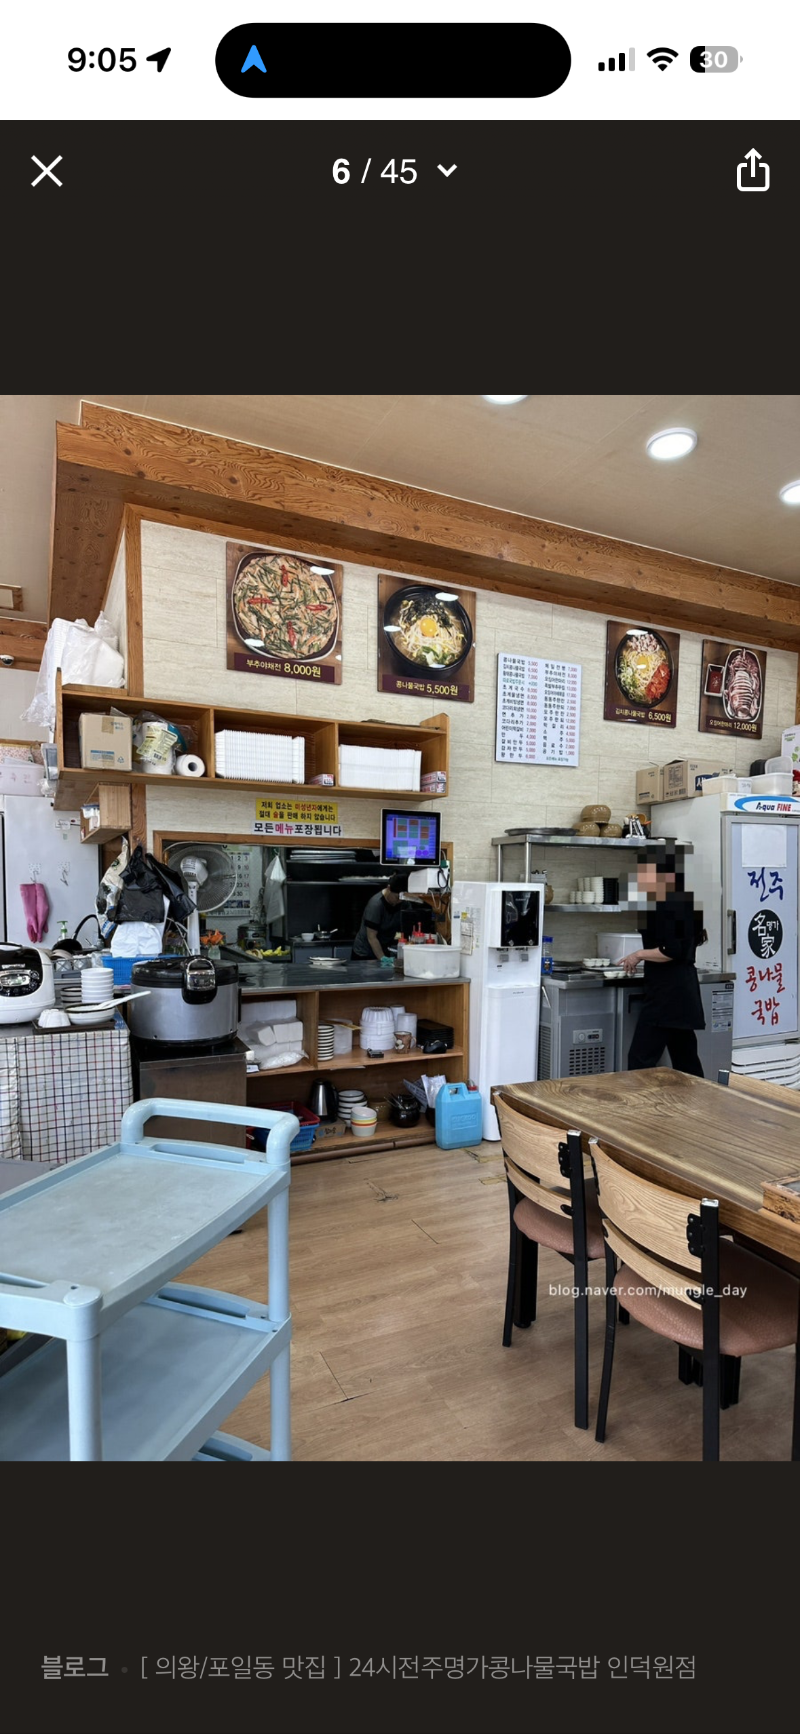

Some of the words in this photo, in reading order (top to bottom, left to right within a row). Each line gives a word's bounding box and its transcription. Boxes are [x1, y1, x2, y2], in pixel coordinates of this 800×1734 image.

[246, 659, 281, 672] 부추야채전
[284, 662, 321, 678] 8,000원
[396, 681, 425, 691] 콩나물국밥
[426, 684, 458, 696] 5,500원
[615, 708, 645, 718] 김치콩나물국밥
[648, 711, 672, 723] 6,500원
[733, 722, 757, 733] 12,000원
[275, 802, 292, 810] 업소는
[295, 804, 334, 812] 미성년자에게는
[756, 801, 775, 812] Aqua
[777, 802, 791, 812] FINE
[273, 811, 284, 819] 술을
[287, 812, 298, 820] 판매
[314, 813, 335, 821] 않습니다
[254, 823, 342, 836] 모든메뉴포장됩니다
[748, 867, 784, 902] 전주
[745, 962, 785, 993] 콩나물
[751, 998, 781, 1026] 국밥
